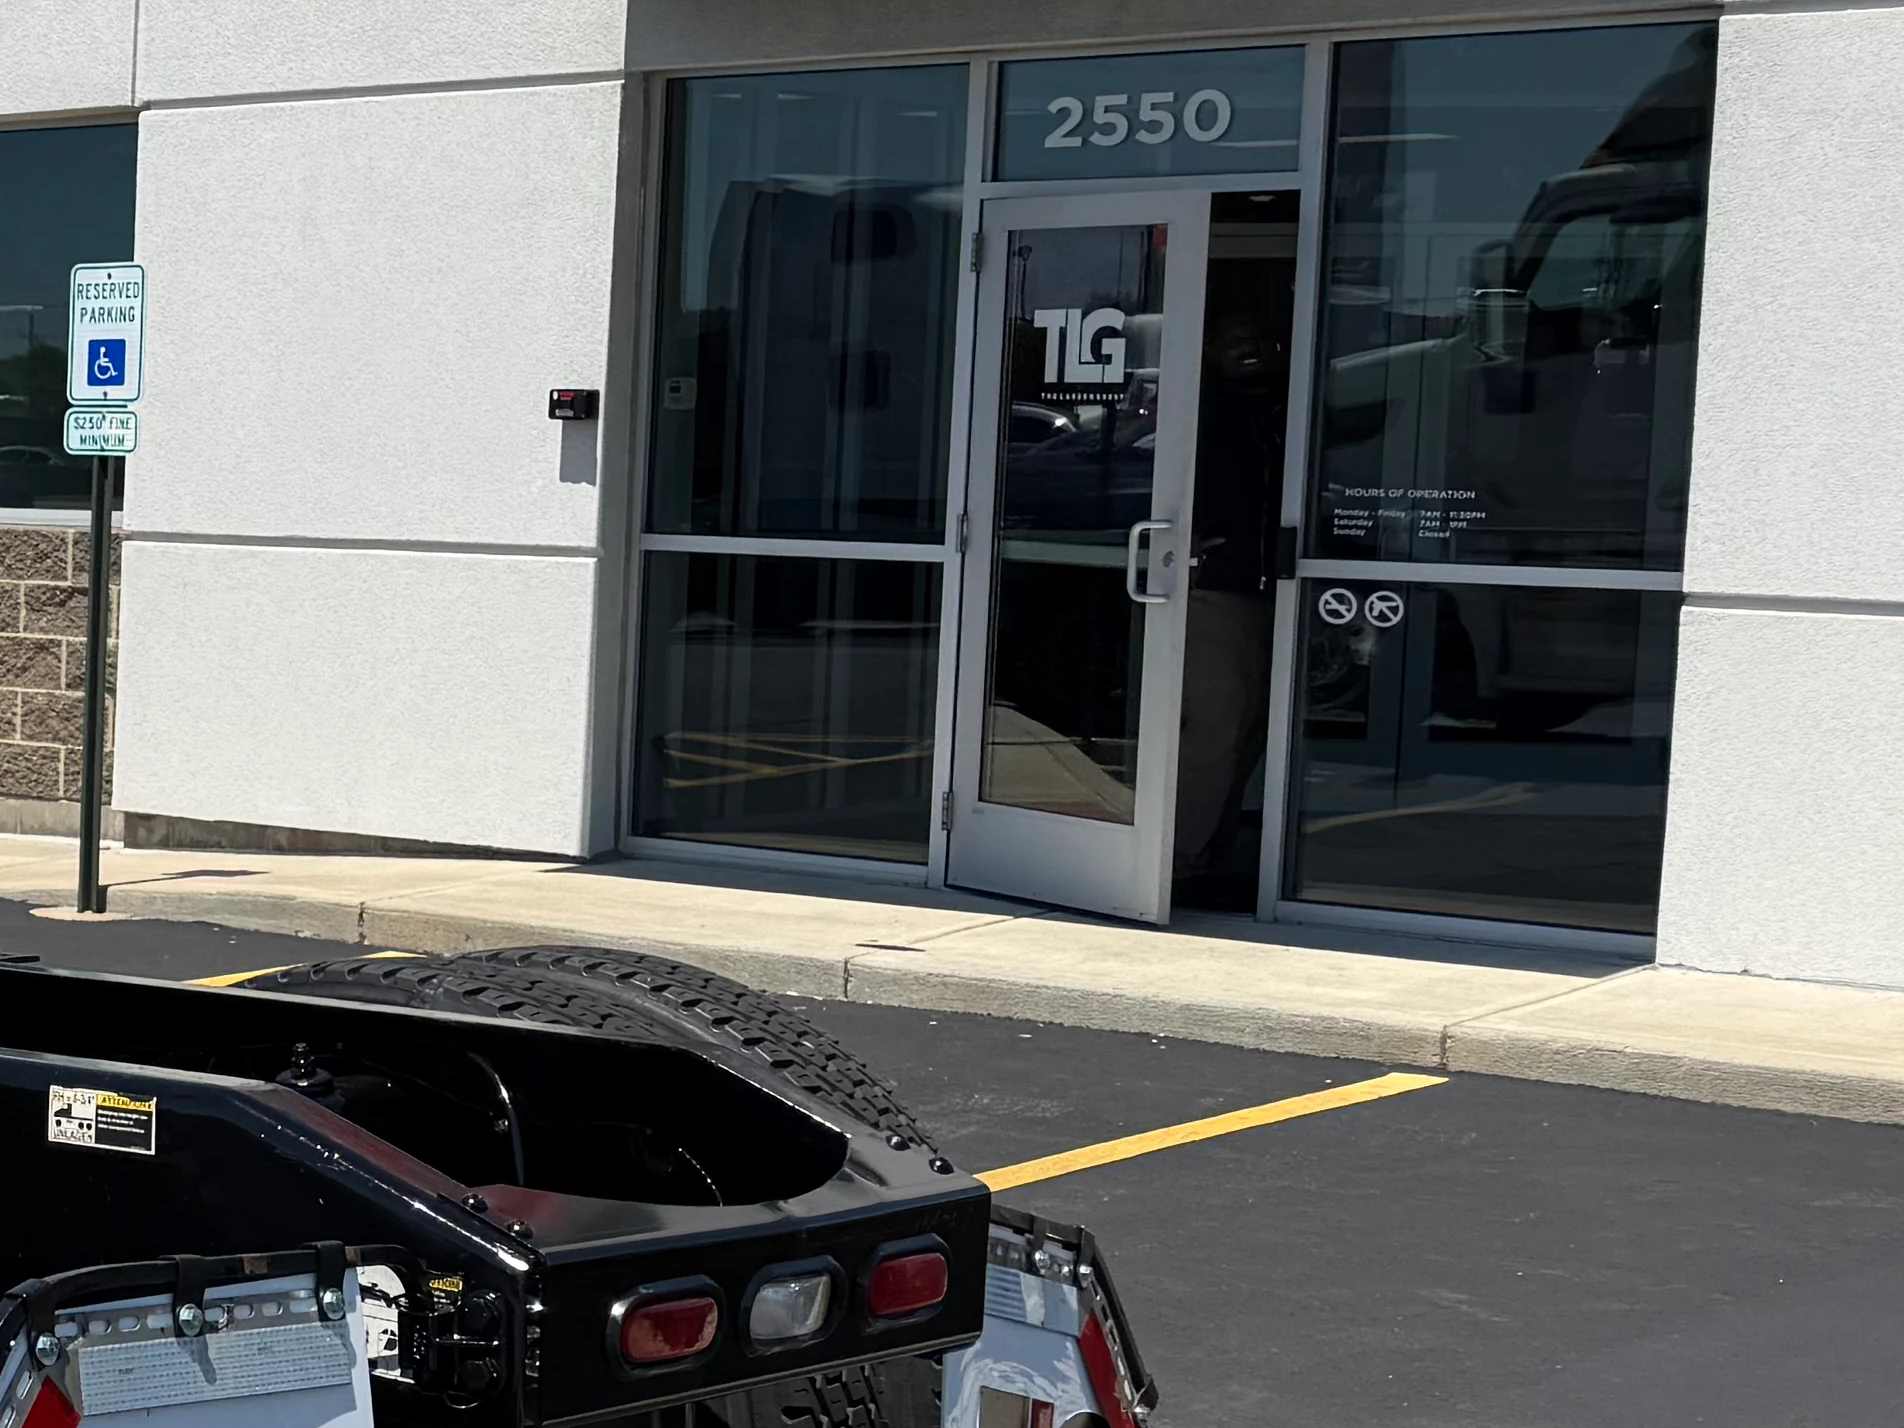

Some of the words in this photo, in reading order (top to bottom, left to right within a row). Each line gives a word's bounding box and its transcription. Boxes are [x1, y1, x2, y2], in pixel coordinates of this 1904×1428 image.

[1044, 88, 1232, 148] 2550
[77, 281, 140, 301] RESERVED
[80, 305, 136, 325] PARKING
[1033, 307, 1126, 383] TLG
[73, 416, 103, 431] $250
[109, 416, 133, 431] FINE
[79, 433, 126, 448] MINIMUM
[1345, 487, 1386, 498] HOURS
[1388, 488, 1404, 498] OF
[1407, 489, 1477, 500] OPERATION
[1333, 508, 1370, 518] Monday
[1377, 509, 1407, 519] Friday
[1333, 517, 1374, 528] Saturday
[1333, 526, 1367, 537] Sunday
[1418, 529, 1451, 539] Closed
